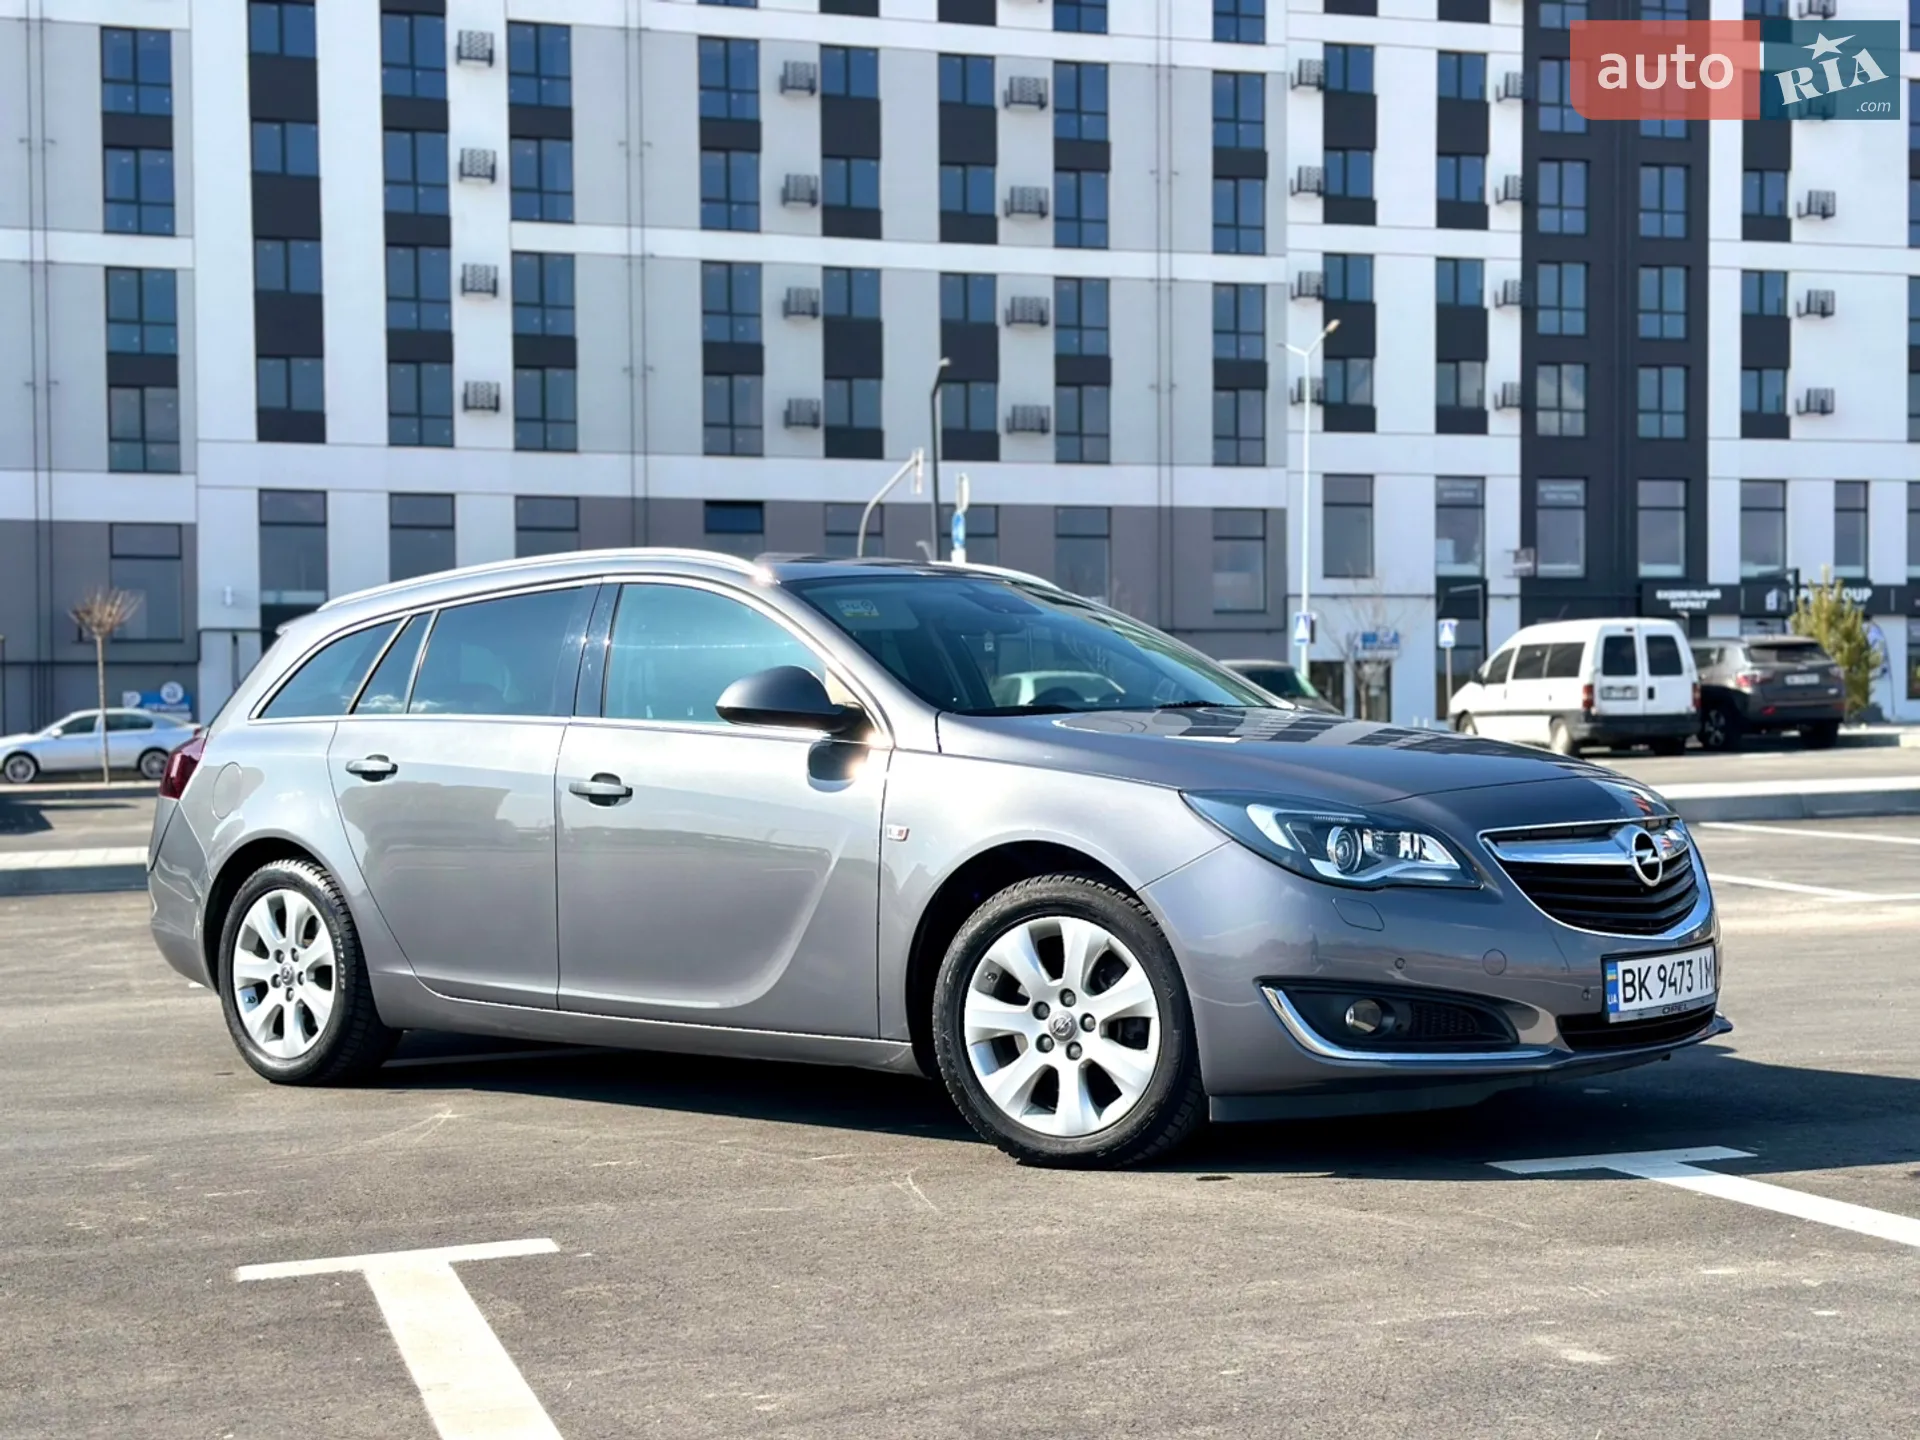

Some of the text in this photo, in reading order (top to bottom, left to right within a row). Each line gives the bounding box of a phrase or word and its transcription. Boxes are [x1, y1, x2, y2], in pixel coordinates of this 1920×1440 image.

[1621, 965, 1653, 1004] BK
[1657, 959, 1694, 999] 9473
[1662, 1003, 1689, 1014] OPEL
